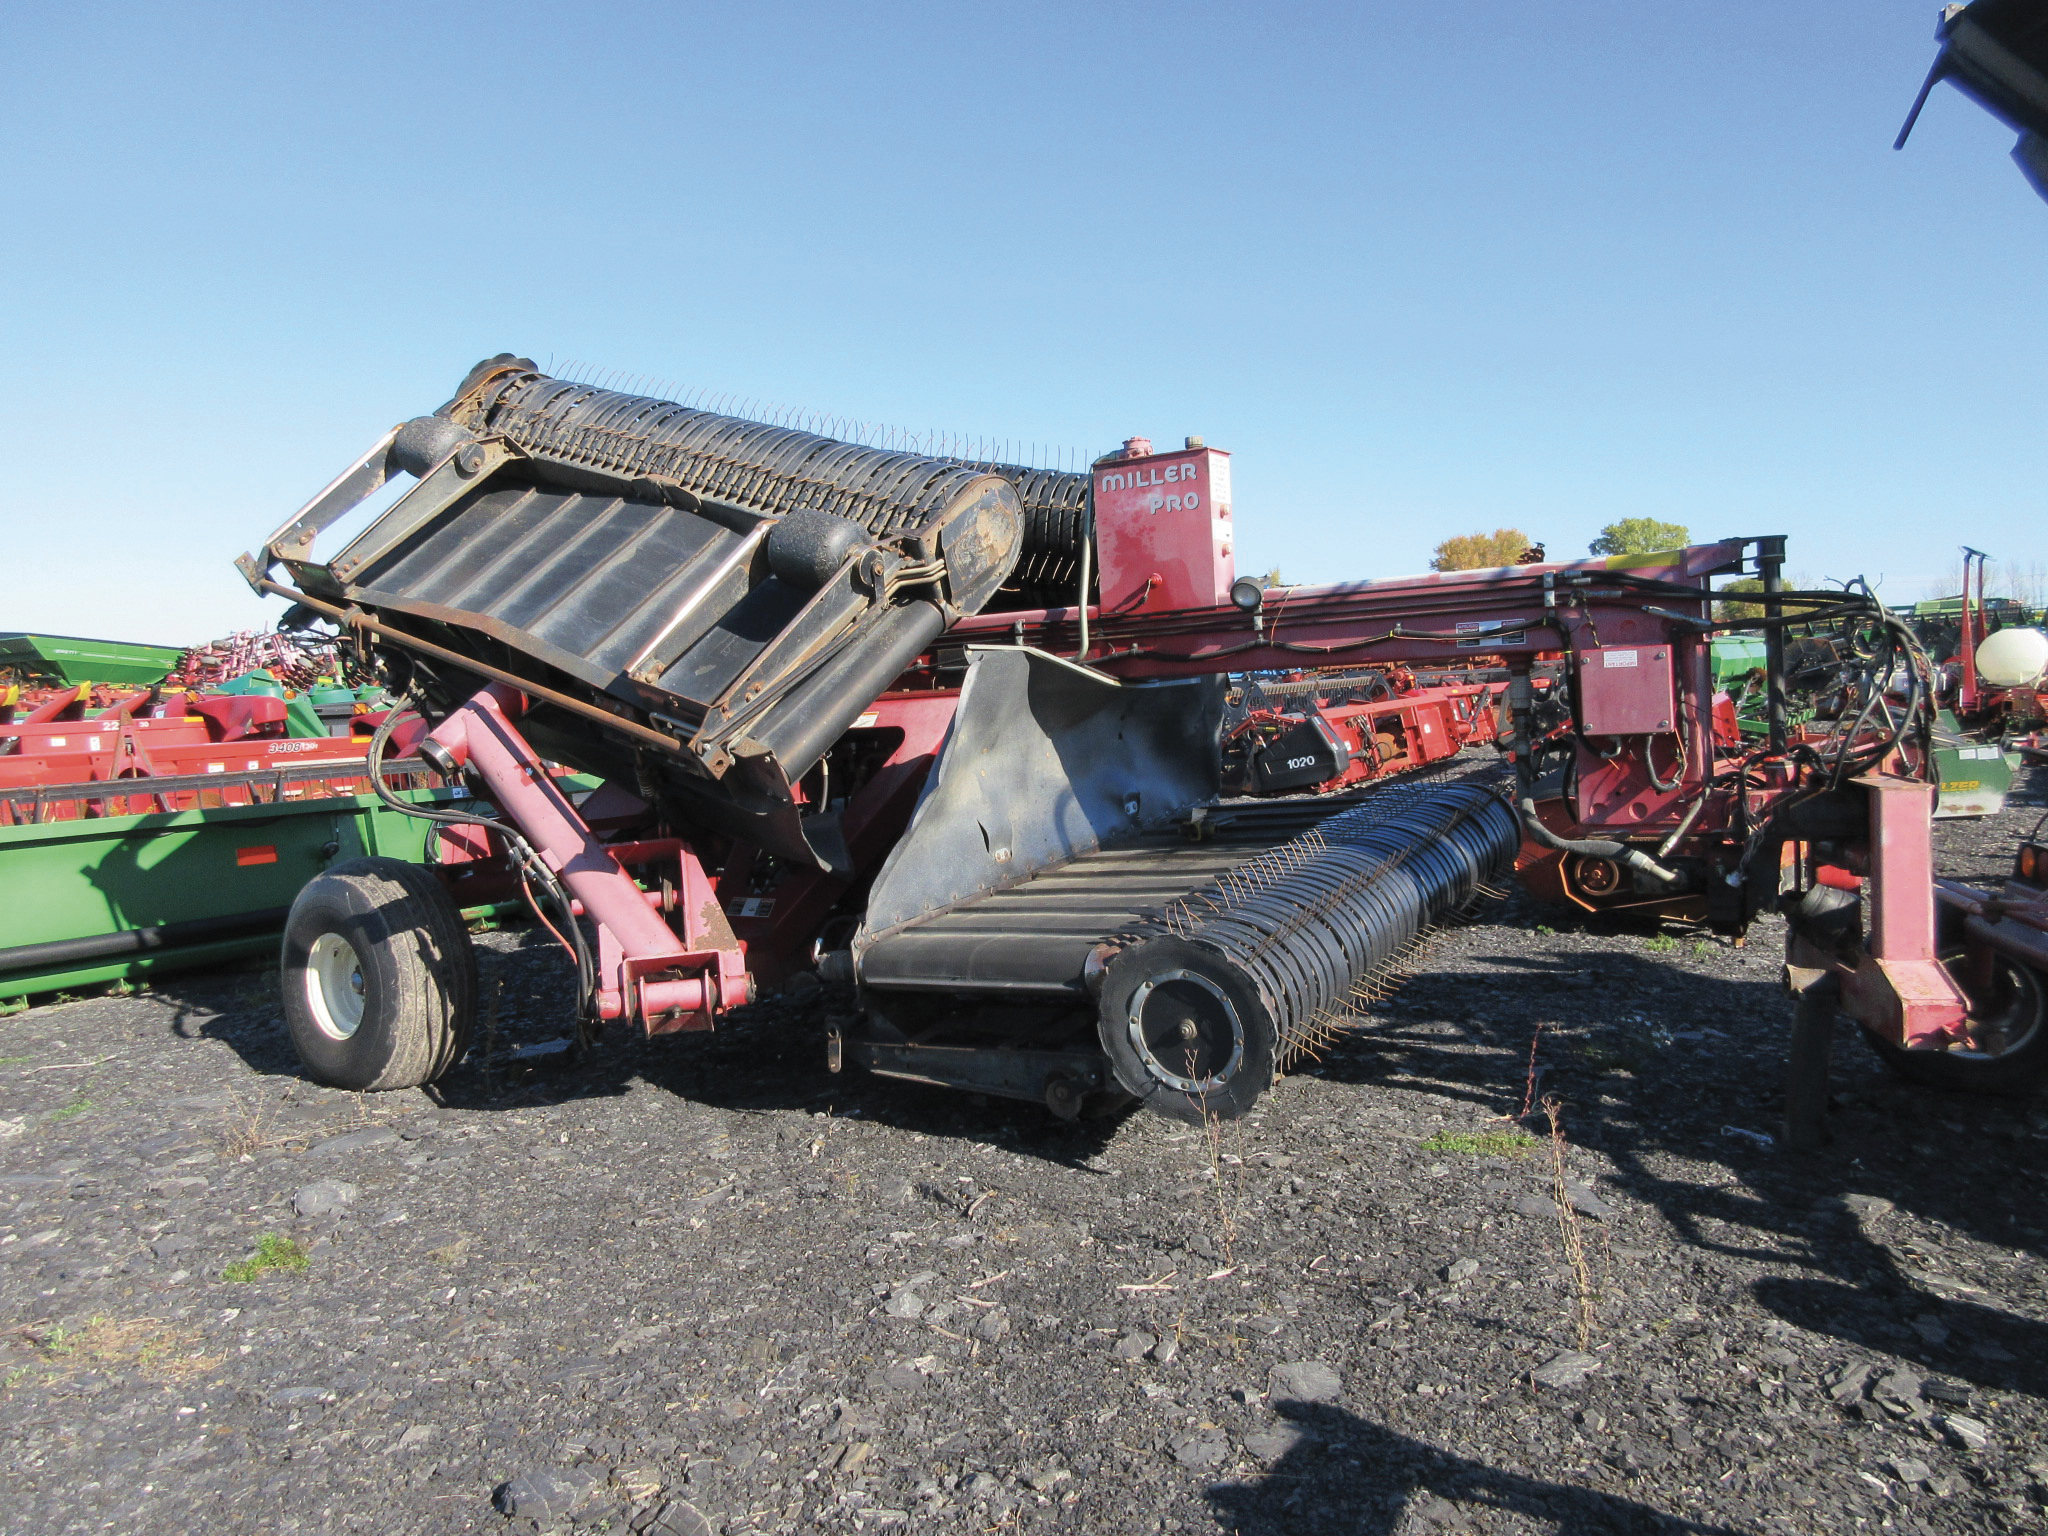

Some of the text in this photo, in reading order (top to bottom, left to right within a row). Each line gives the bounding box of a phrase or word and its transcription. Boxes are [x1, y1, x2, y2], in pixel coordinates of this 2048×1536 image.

[1102, 463, 1197, 493] MILLER
[1151, 491, 1200, 515] PRO
[102, 721, 121, 731] 22
[268, 742, 302, 754] 3408
[1286, 755, 1315, 769] 1020
[1941, 780, 1980, 790] LZER
